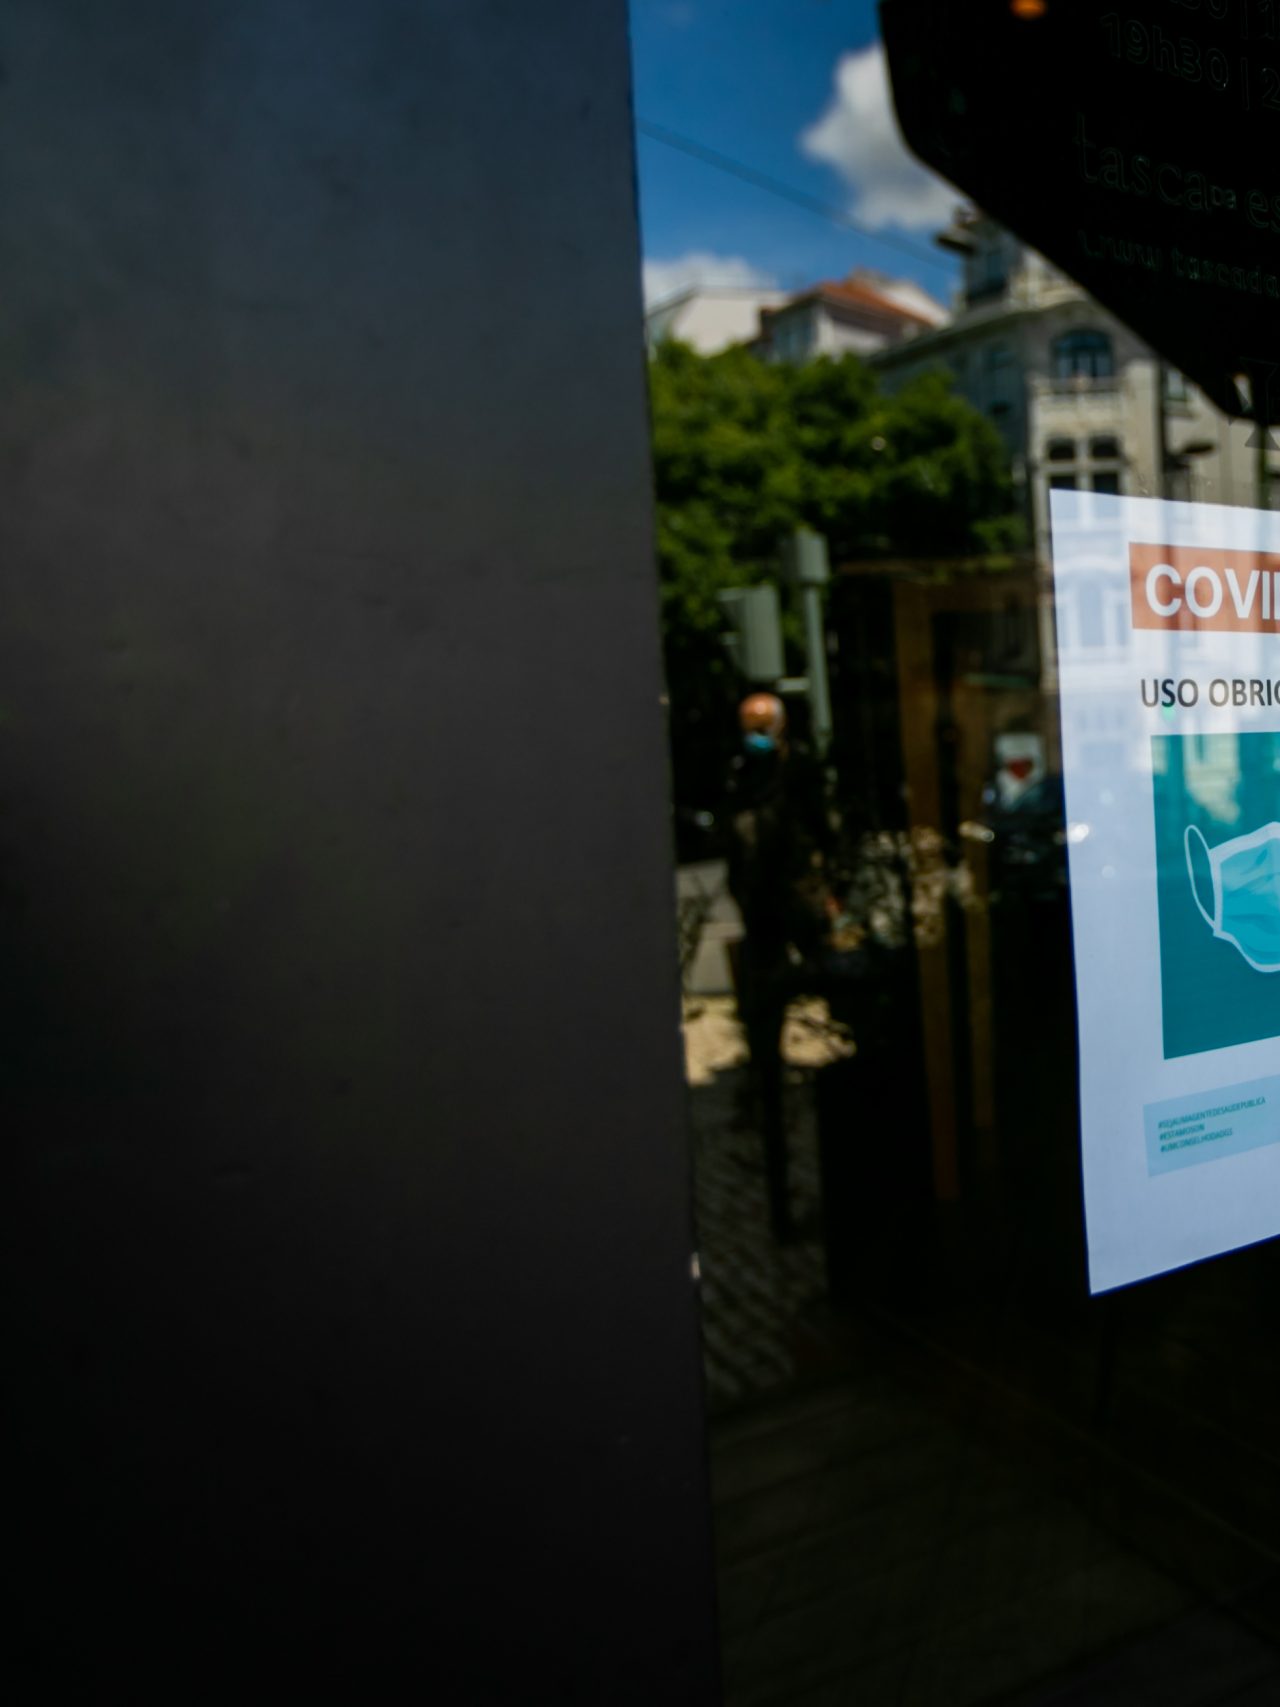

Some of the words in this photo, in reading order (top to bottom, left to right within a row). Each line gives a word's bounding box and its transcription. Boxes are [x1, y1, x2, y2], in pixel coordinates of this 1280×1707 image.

[1099, 11, 1231, 93] 19h30
[1072, 111, 1213, 215] tasca
[1141, 678, 1199, 708] USO
